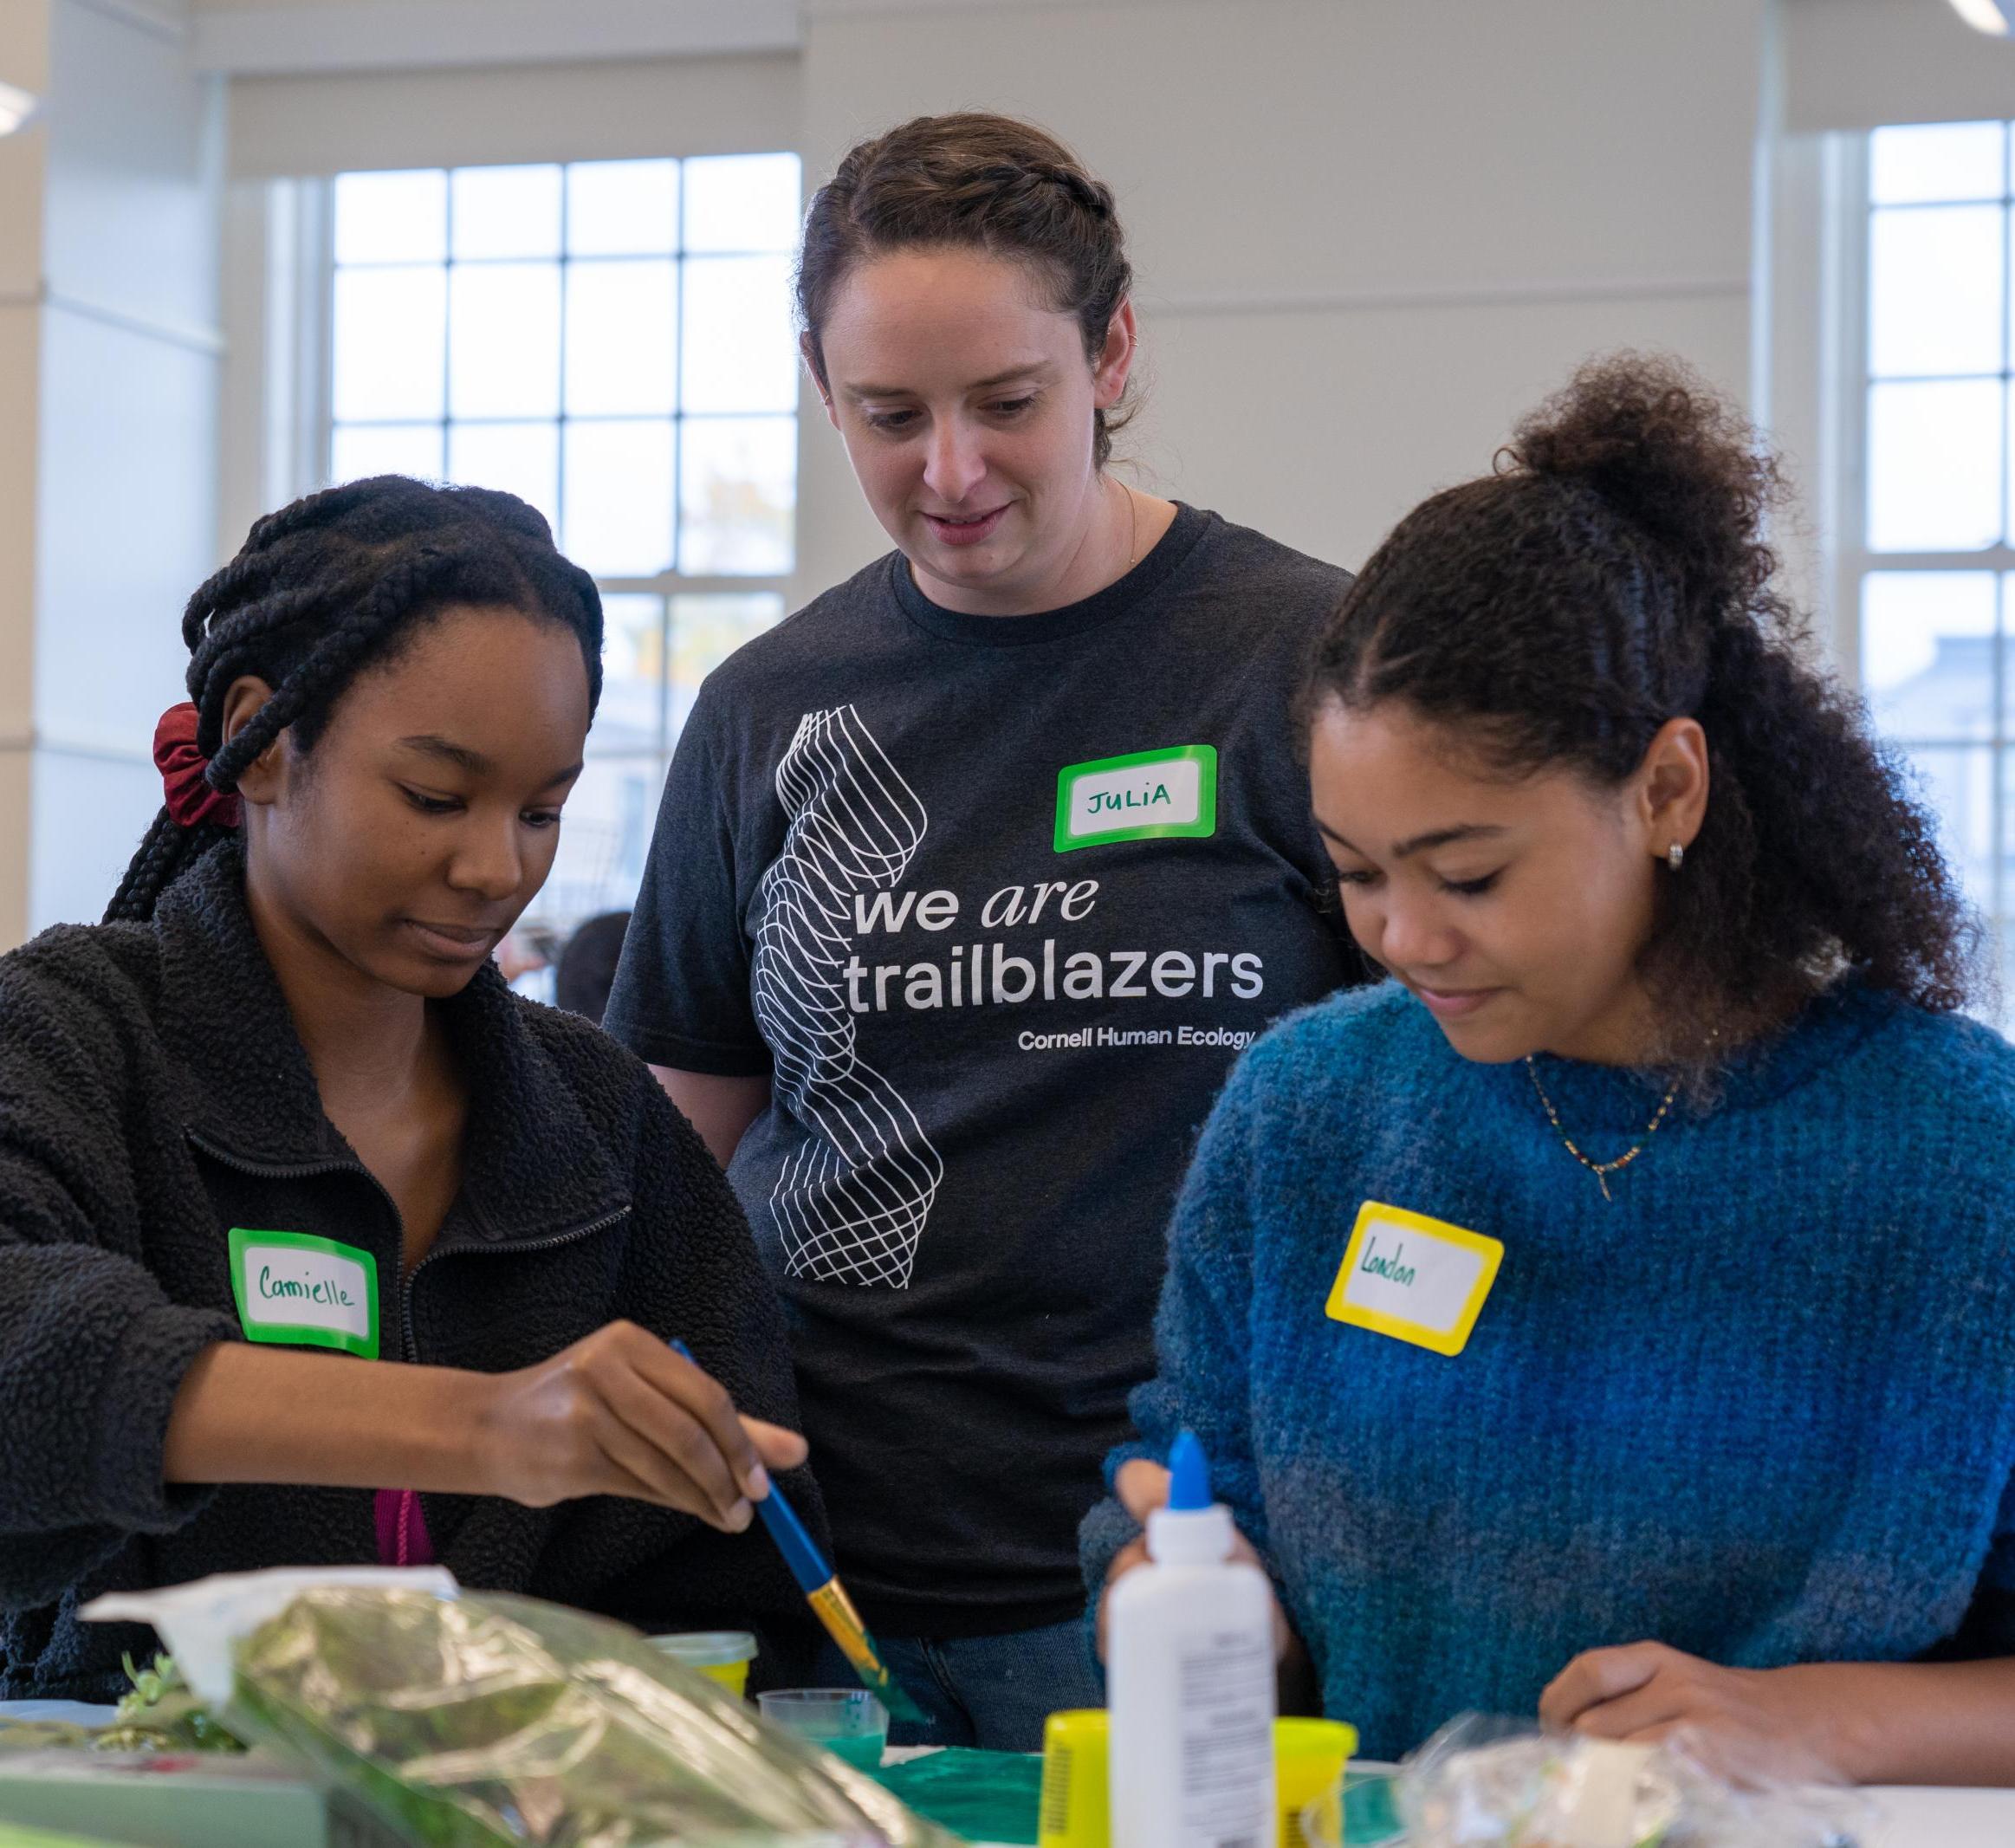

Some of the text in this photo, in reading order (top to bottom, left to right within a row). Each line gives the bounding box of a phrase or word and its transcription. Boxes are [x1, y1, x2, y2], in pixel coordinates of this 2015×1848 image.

[854, 879, 1099, 934] we are
[842, 938, 1264, 1013] trailblazers
[1018, 1026, 1256, 1051] Cornell Human Ecology
[259, 1265, 355, 1307] Camielle
[1361, 1235, 1416, 1287] London
